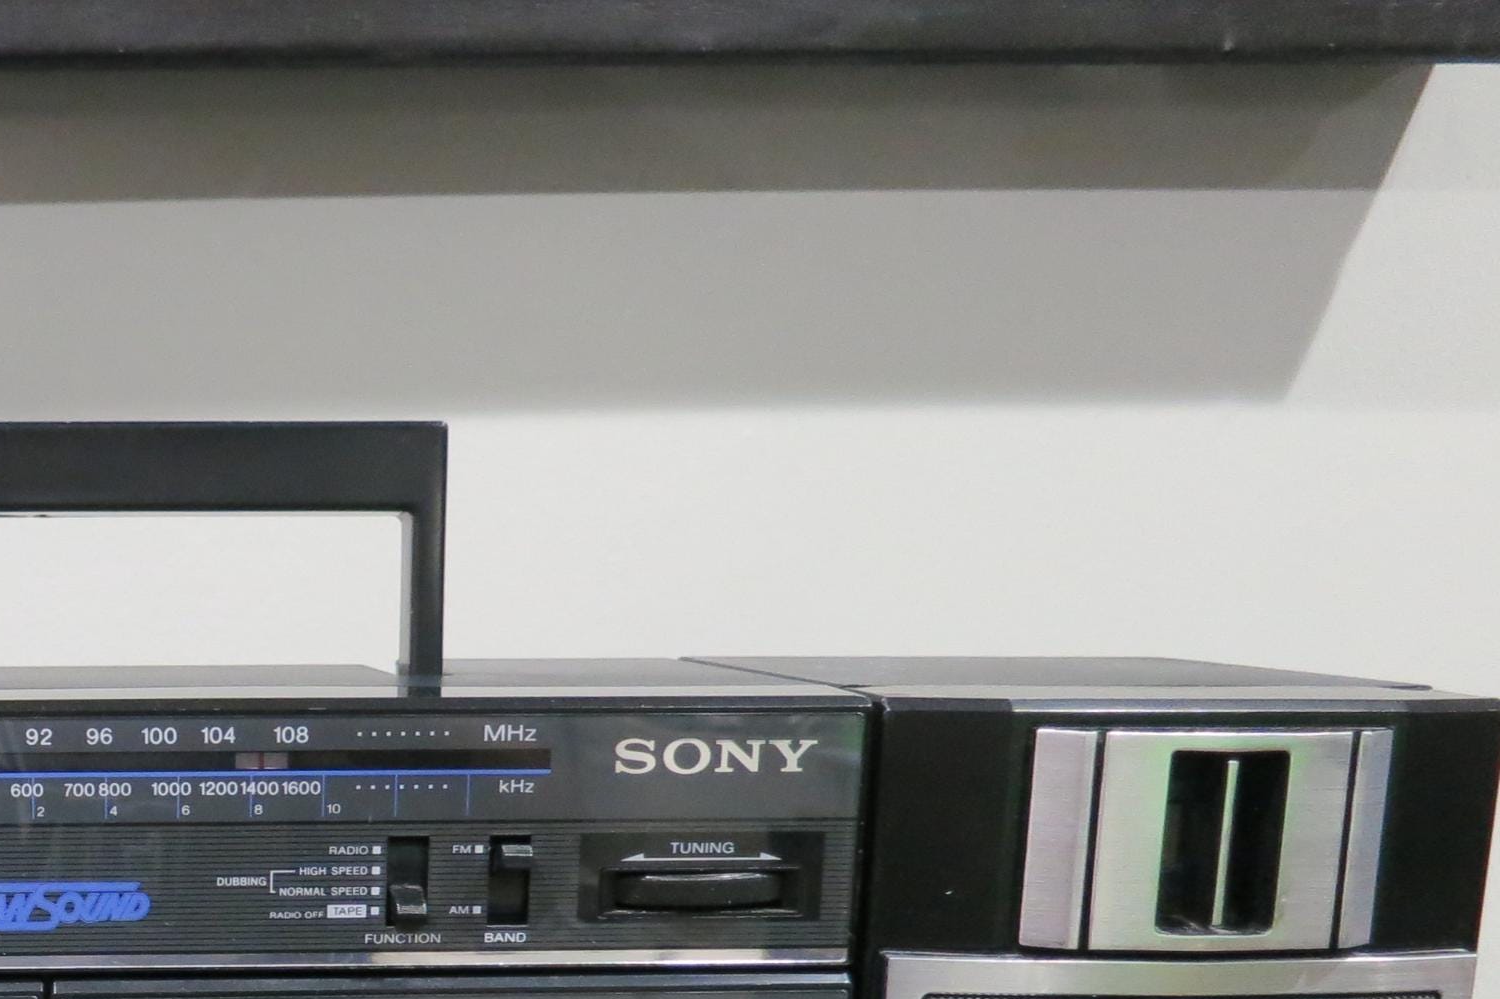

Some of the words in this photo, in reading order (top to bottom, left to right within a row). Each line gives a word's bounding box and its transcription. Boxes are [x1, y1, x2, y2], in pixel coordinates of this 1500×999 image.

[25, 729, 52, 745] 92
[86, 728, 113, 745] 96
[141, 727, 178, 745] 100
[201, 727, 236, 744] 104
[273, 726, 309, 744] 108
[483, 724, 537, 742] MHz
[615, 738, 818, 775] SONY
[10, 784, 43, 798] 600
[64, 783, 95, 797] 700
[98, 783, 132, 797] 800
[151, 782, 191, 796] 1000
[199, 782, 238, 795] 1200
[240, 781, 279, 795] 1400
[282, 781, 321, 795] 1600
[499, 779, 534, 793] kHz
[37, 806, 45, 817] 2
[109, 806, 118, 816] 4
[181, 805, 190, 816] 6
[254, 804, 263, 815] 8
[327, 803, 341, 814] 10
[329, 846, 369, 855] RADIO
[452, 844, 471, 854] FM
[670, 842, 735, 854] TUNING
[299, 866, 327, 876] HIGH
[331, 866, 368, 875] SPEED
[216, 877, 267, 887] DUBBING
[279, 887, 326, 897] NORMAL
[331, 887, 368, 896] SPEED
[269, 911, 302, 919] RADIO
[304, 910, 324, 919] OFF
[332, 907, 363, 916] TAPE
[449, 905, 469, 915] AM
[364, 933, 441, 944] FUNCTION
[484, 932, 527, 943] BAND
